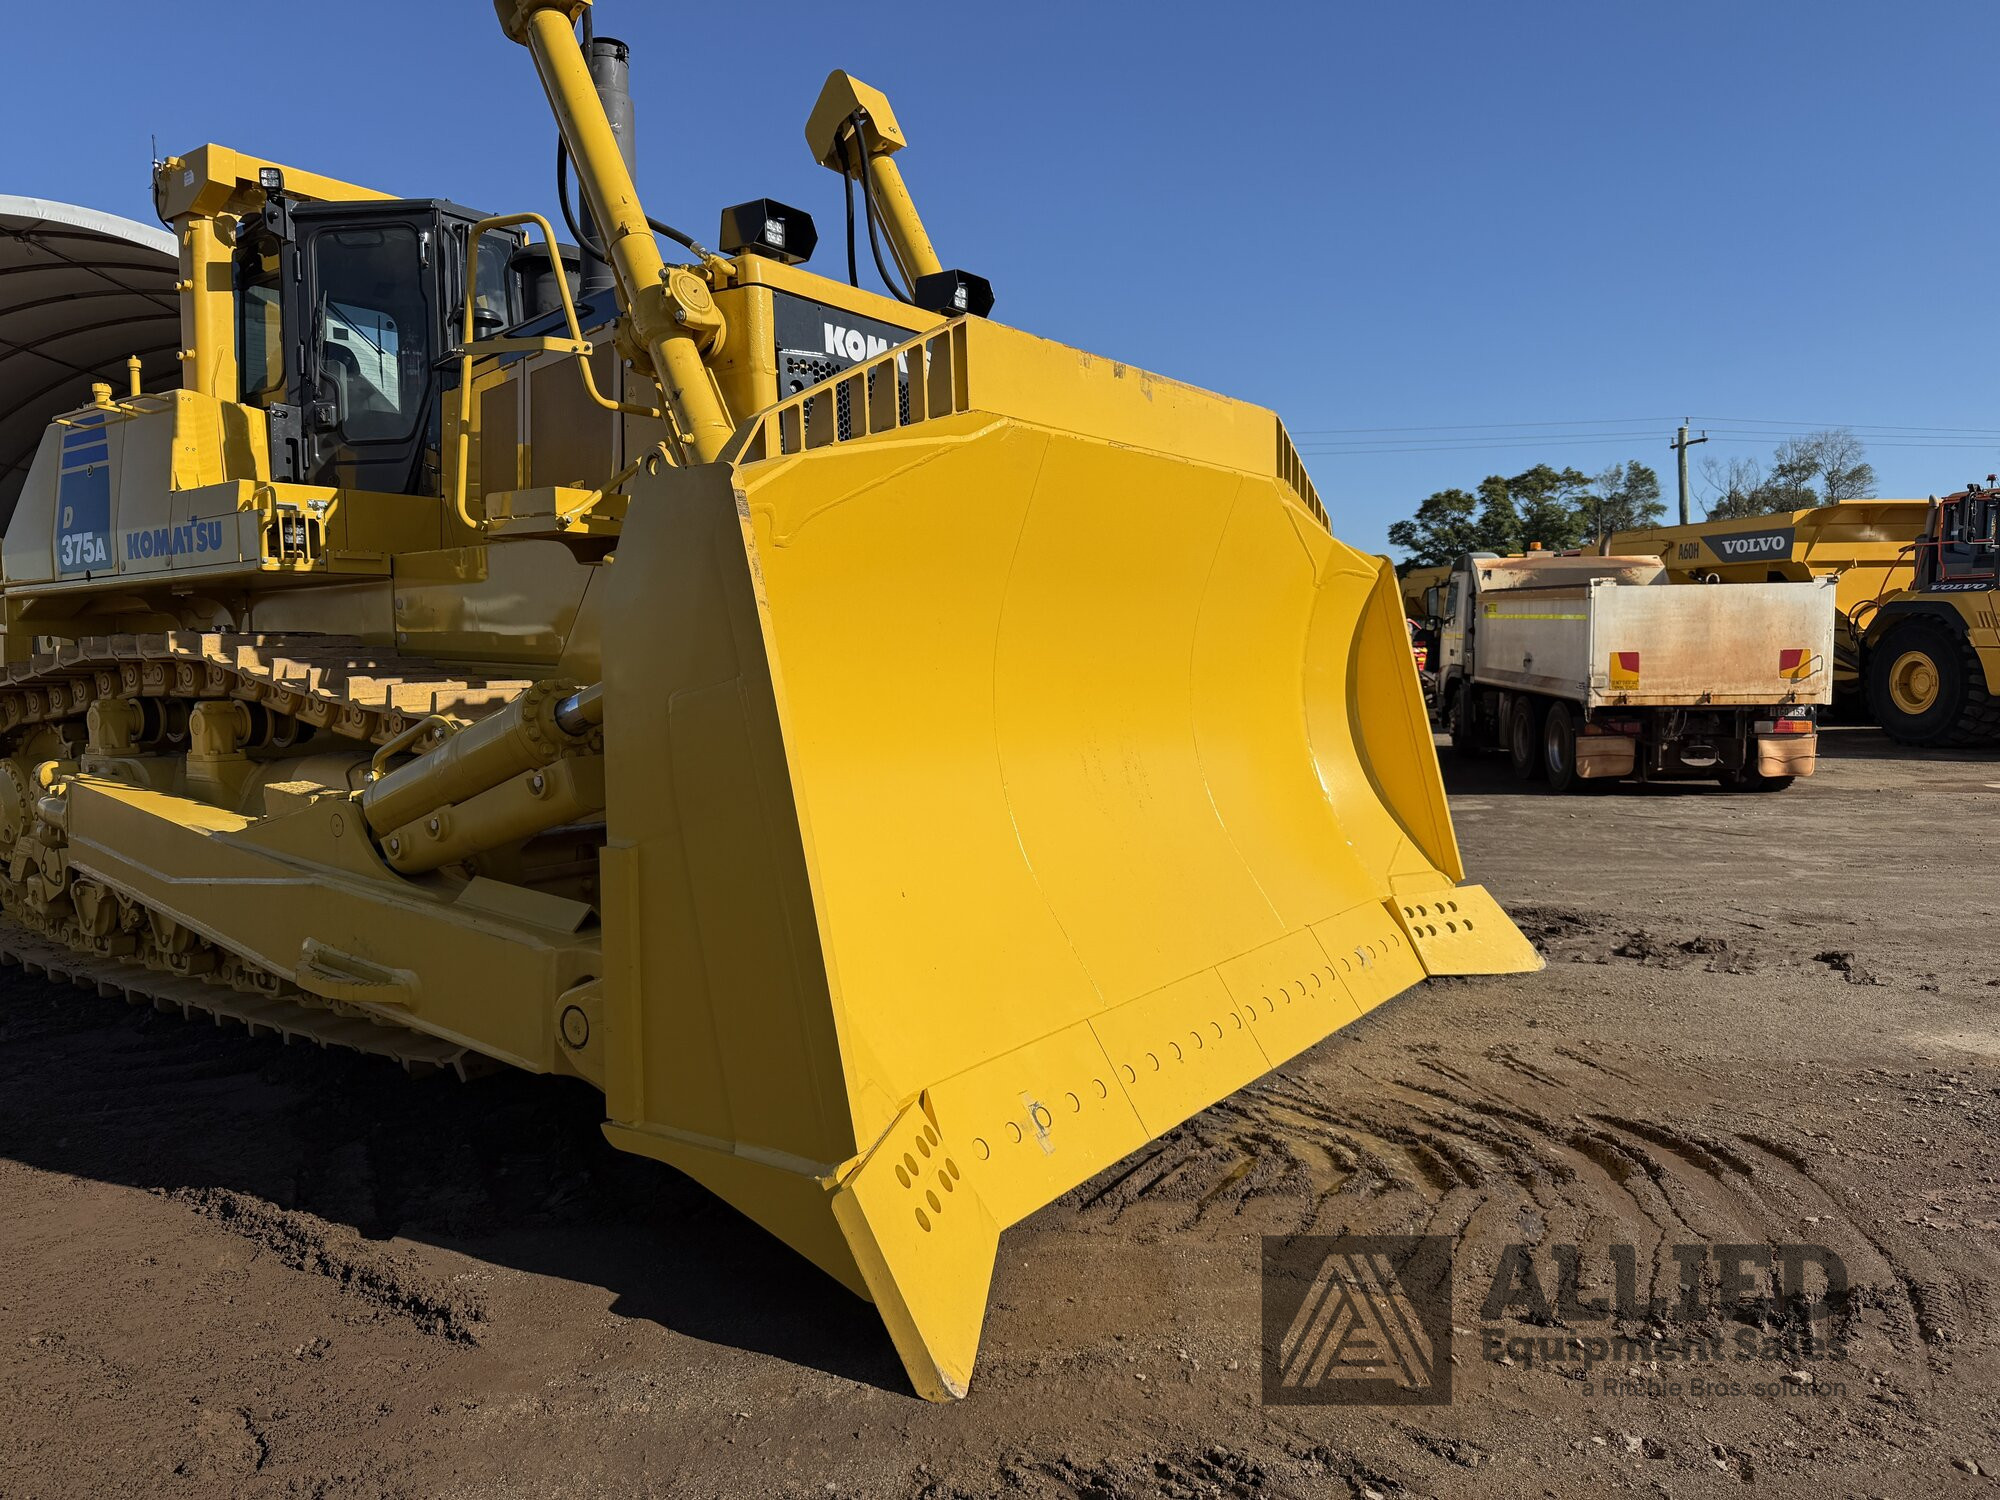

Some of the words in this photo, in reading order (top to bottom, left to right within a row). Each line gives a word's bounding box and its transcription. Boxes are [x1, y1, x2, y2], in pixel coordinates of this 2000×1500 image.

[63, 506, 73, 529] D
[126, 515, 223, 560] KOMATSU
[1722, 536, 1785, 554] VOLVO
[61, 531, 107, 566] 375A
[1678, 542, 1699, 560] A60H
[1931, 583, 1987, 591] VOLVO
